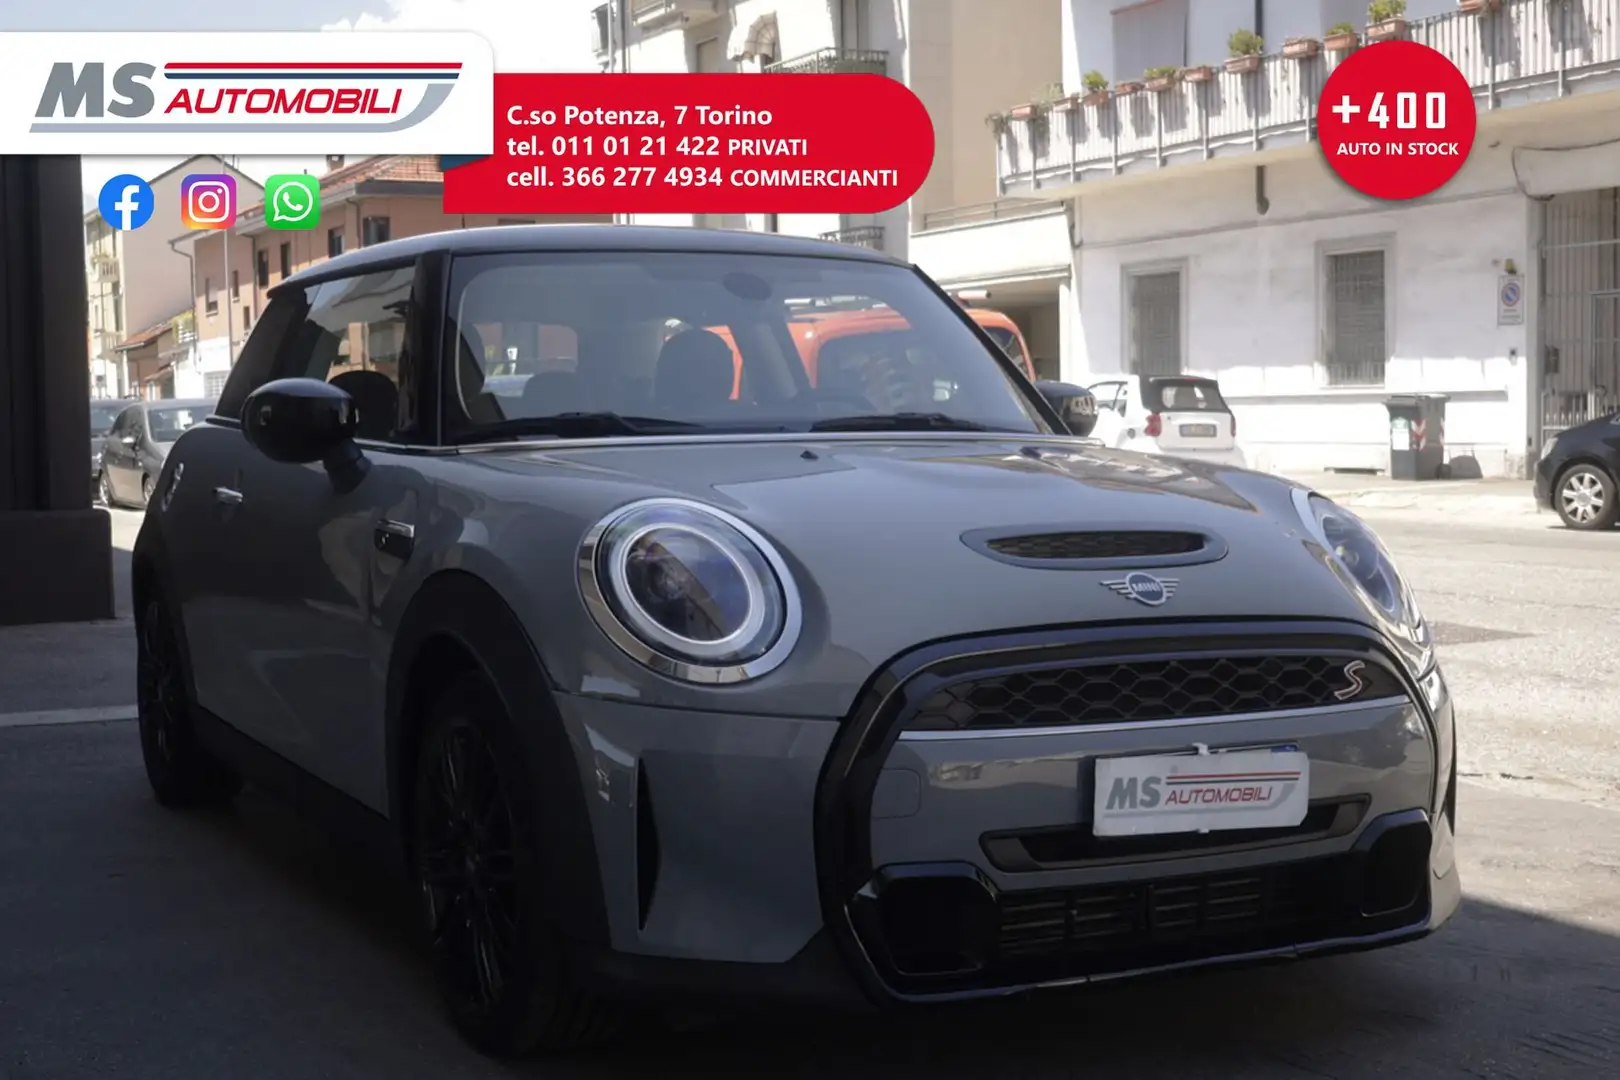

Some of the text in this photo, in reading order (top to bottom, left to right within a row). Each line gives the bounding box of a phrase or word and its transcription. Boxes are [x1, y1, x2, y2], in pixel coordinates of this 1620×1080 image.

[1131, 581, 1161, 593] MINI
[1105, 776, 1273, 811] MS AUTOMOBILI
